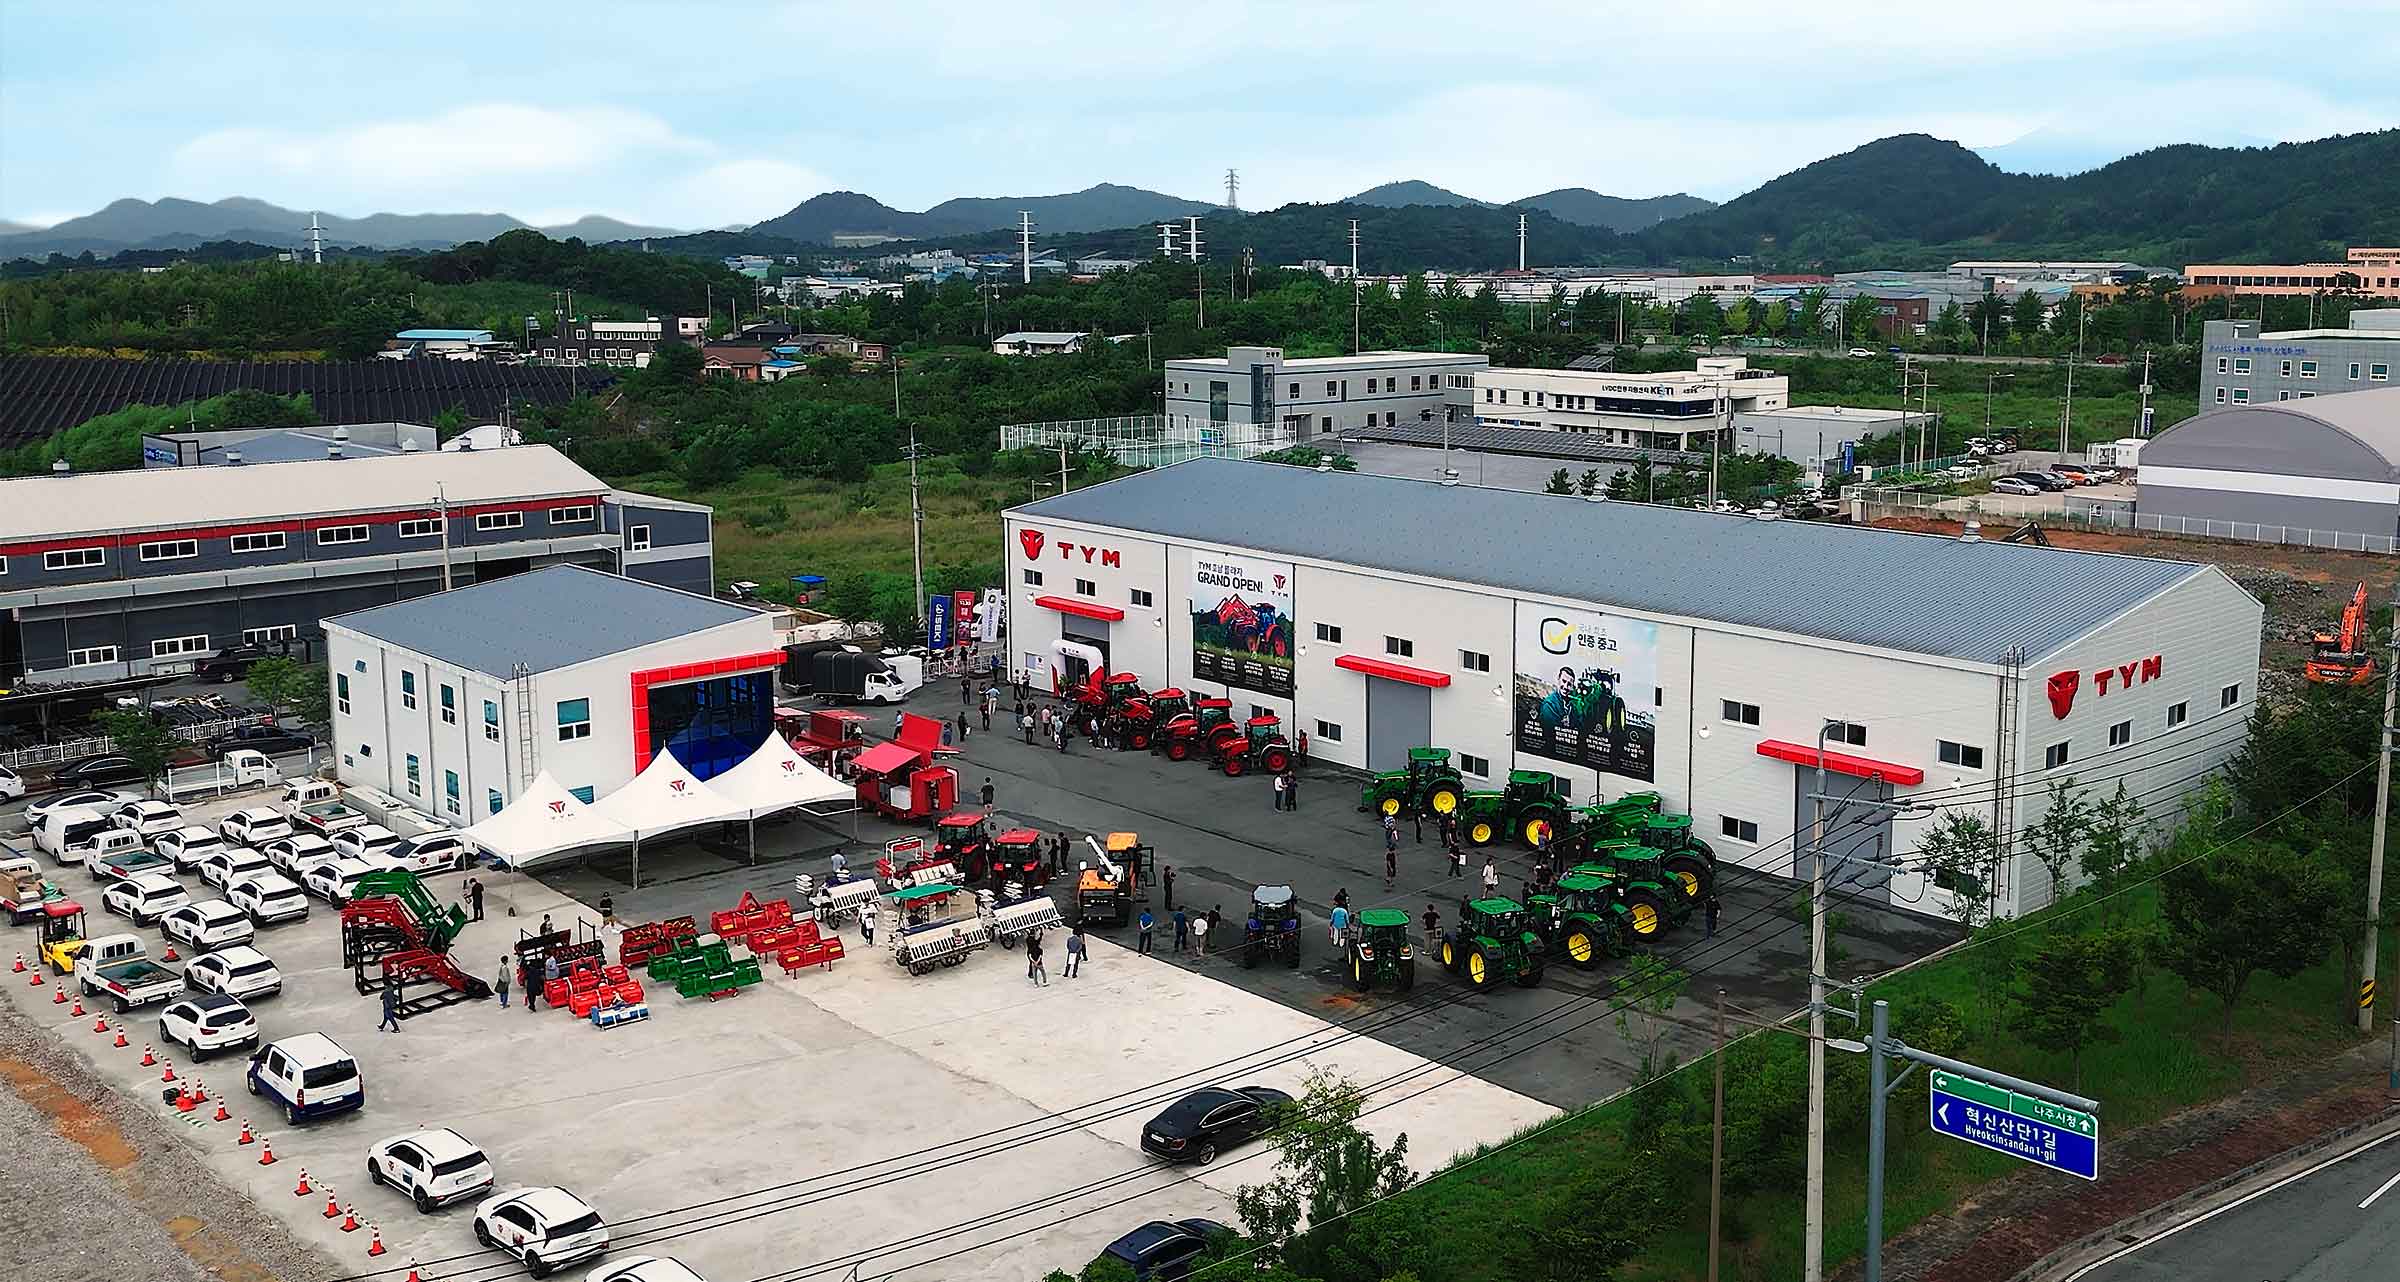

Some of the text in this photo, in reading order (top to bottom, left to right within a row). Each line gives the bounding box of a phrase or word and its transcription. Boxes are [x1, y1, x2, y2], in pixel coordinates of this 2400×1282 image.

[1057, 541, 1121, 568] TYM
[1199, 561, 1211, 570] TYM
[1197, 572, 1264, 593] GRAND OPEN!
[934, 614, 943, 642] ISEKI
[1577, 633, 1617, 651] 인증 중고
[2094, 655, 2163, 697] TYM
[1965, 1106, 2057, 1151] 혁신산단1길
[2034, 1105, 2077, 1128] 나주시청
